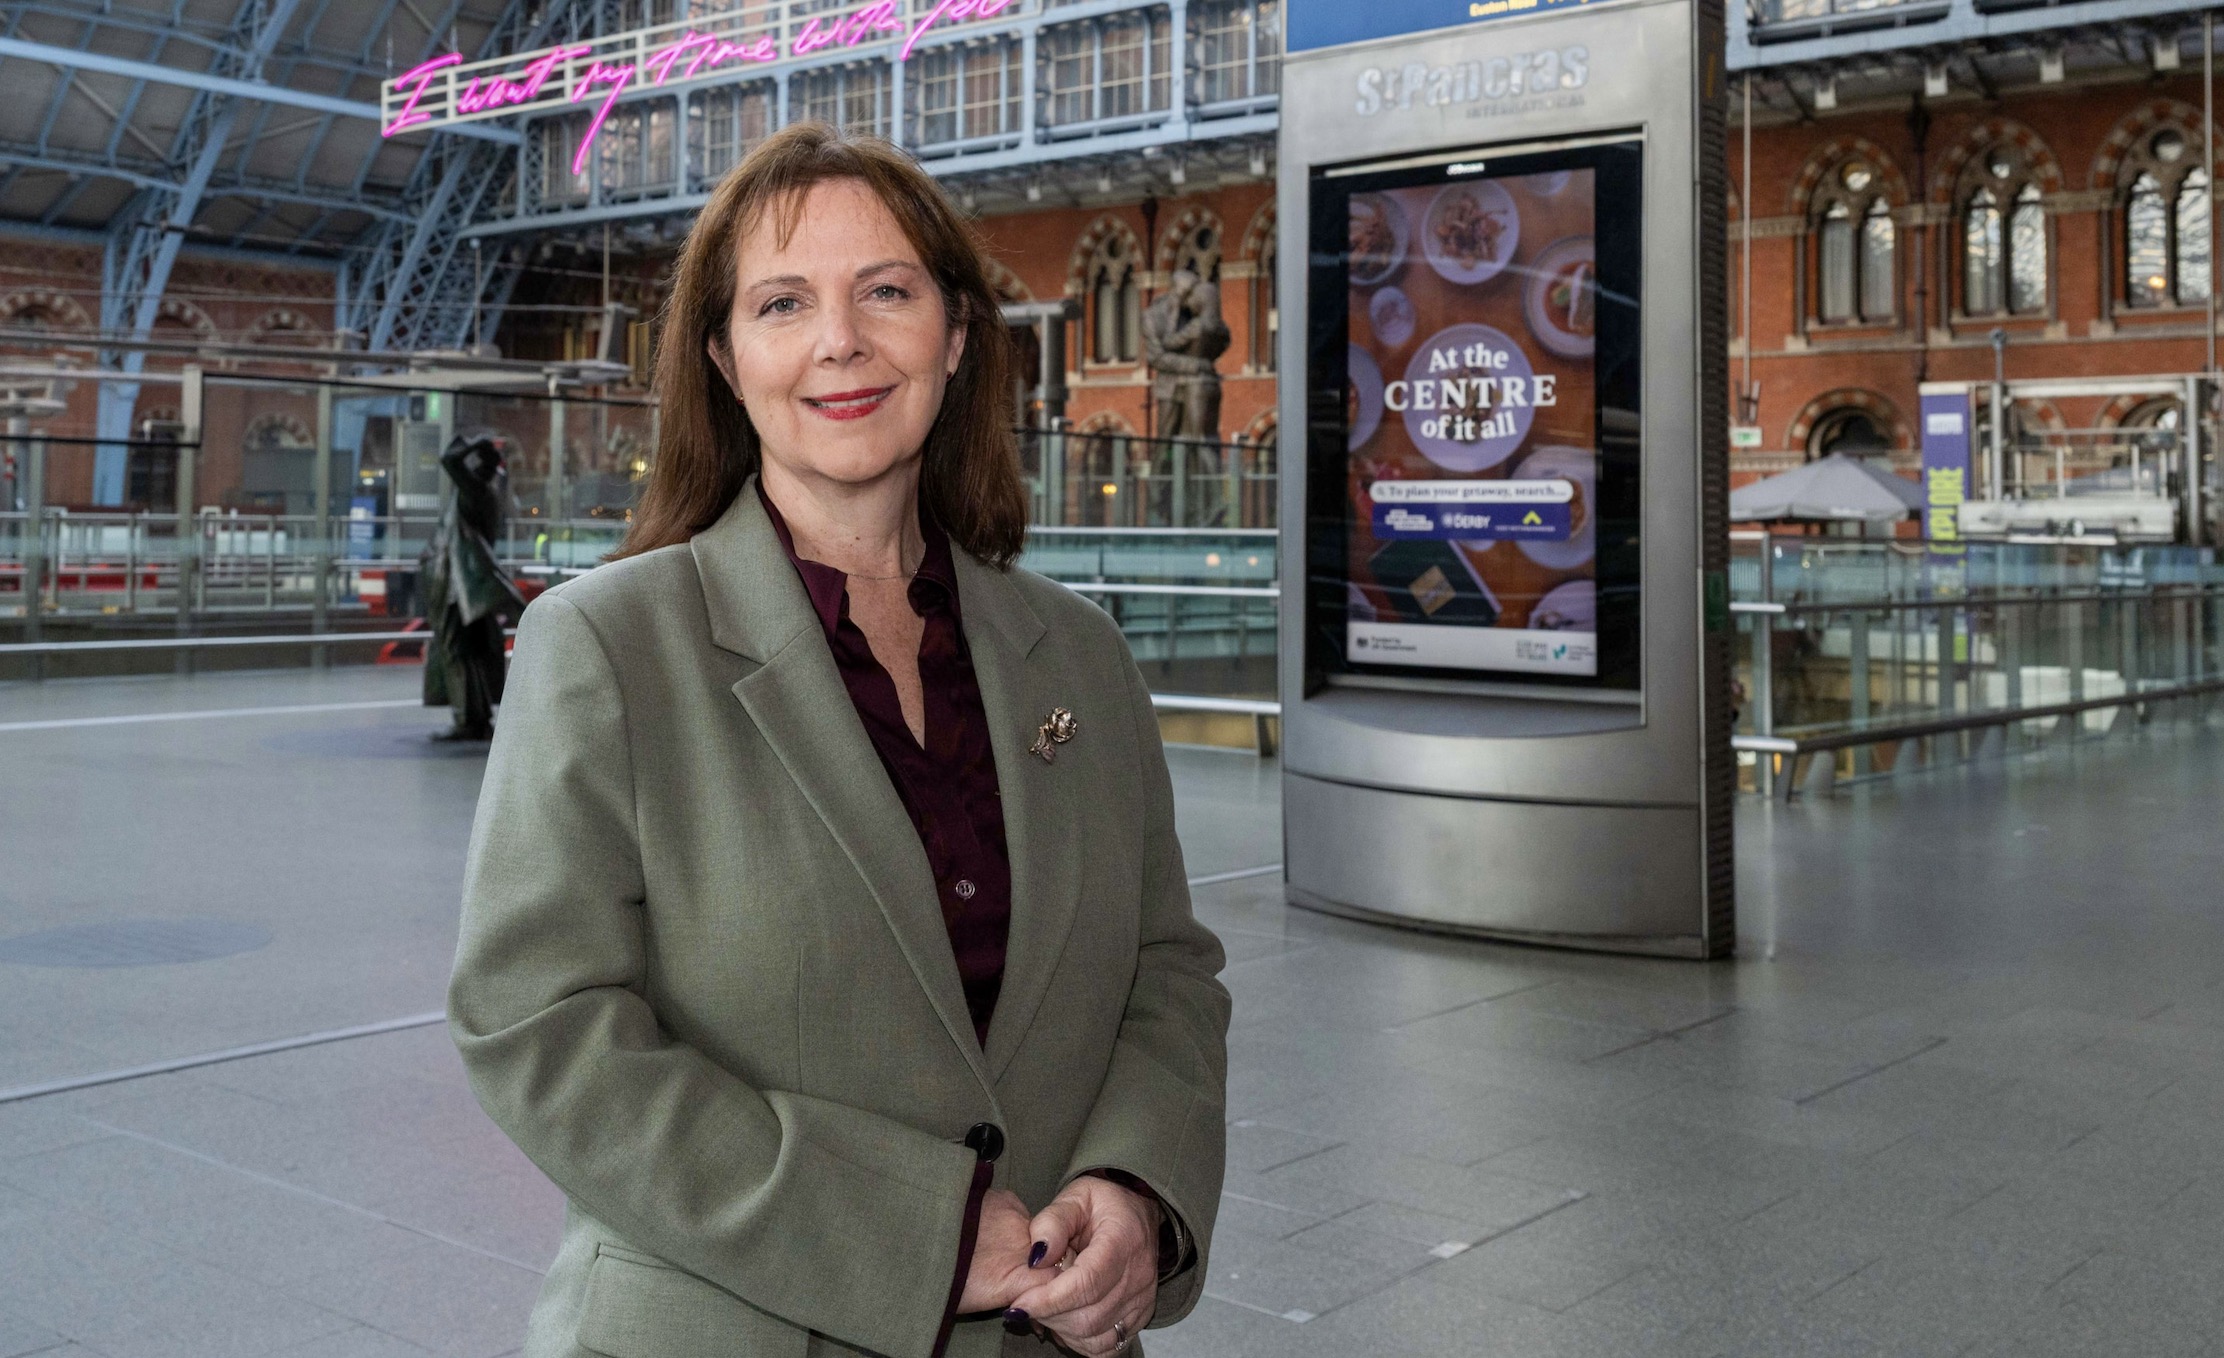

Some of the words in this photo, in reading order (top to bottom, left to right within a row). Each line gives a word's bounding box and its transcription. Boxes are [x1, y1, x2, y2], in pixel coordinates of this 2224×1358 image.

[382, 52, 463, 138] I
[572, 62, 636, 174] my
[1428, 348, 1459, 373] At
[1463, 342, 1510, 369] the
[1383, 374, 1558, 411] CENTRE
[1420, 414, 1451, 441] of
[1453, 415, 1476, 440] it
[1480, 411, 1518, 439] all
[1405, 485, 1431, 499] plan
[1433, 488, 1459, 499] your
